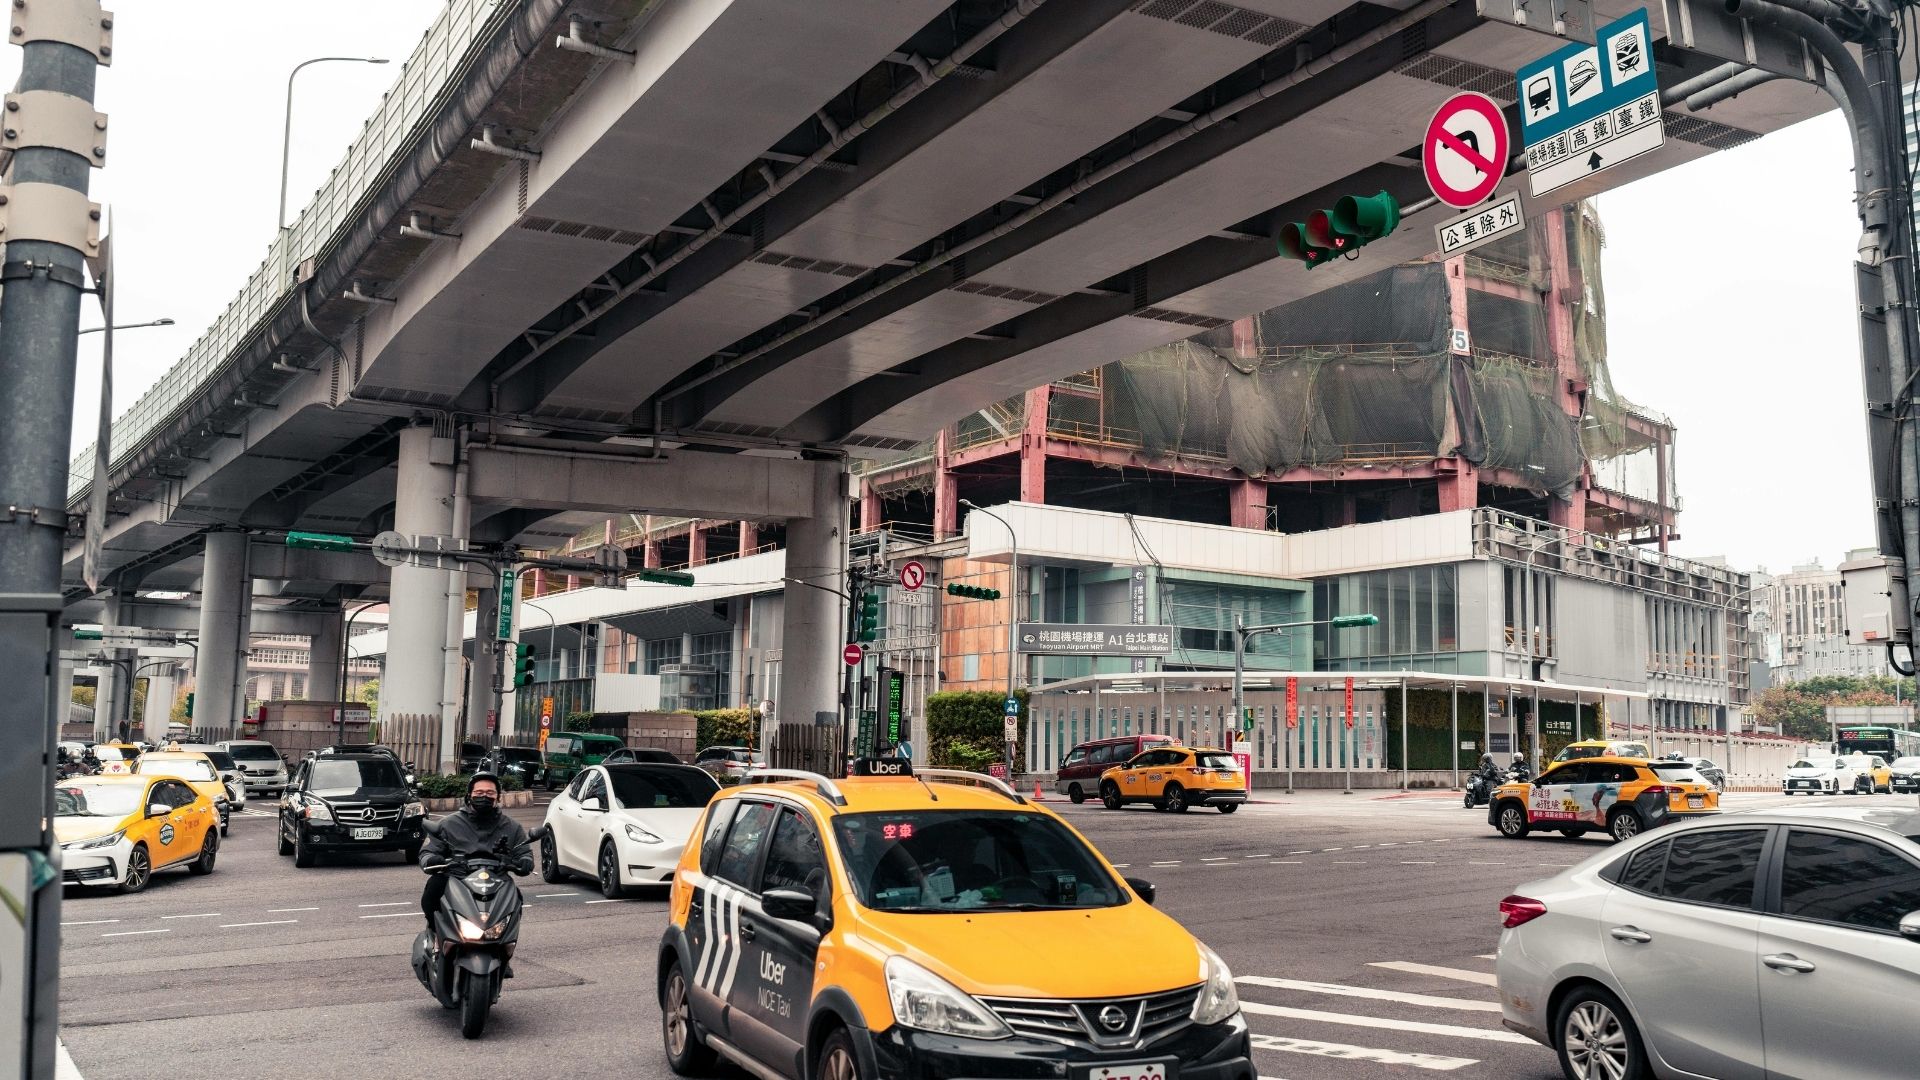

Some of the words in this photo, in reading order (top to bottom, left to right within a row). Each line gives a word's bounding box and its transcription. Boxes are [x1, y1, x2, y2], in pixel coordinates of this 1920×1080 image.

[1618, 99, 1655, 128] 臺鐵
[1572, 118, 1610, 147] 高鐵
[1528, 135, 1567, 166] 機場捷運
[1446, 207, 1514, 247] 公車除外
[1455, 330, 1466, 349] 5
[1039, 630, 1104, 643] 桃園機場捷運
[1109, 634, 1123, 646] A1
[1125, 632, 1169, 644] 台北車站
[870, 760, 902, 774] Uber
[883, 823, 913, 839] 空車
[760, 950, 787, 985] Uber
[758, 986, 776, 1012] NICE
[776, 993, 791, 1018] Taxi
